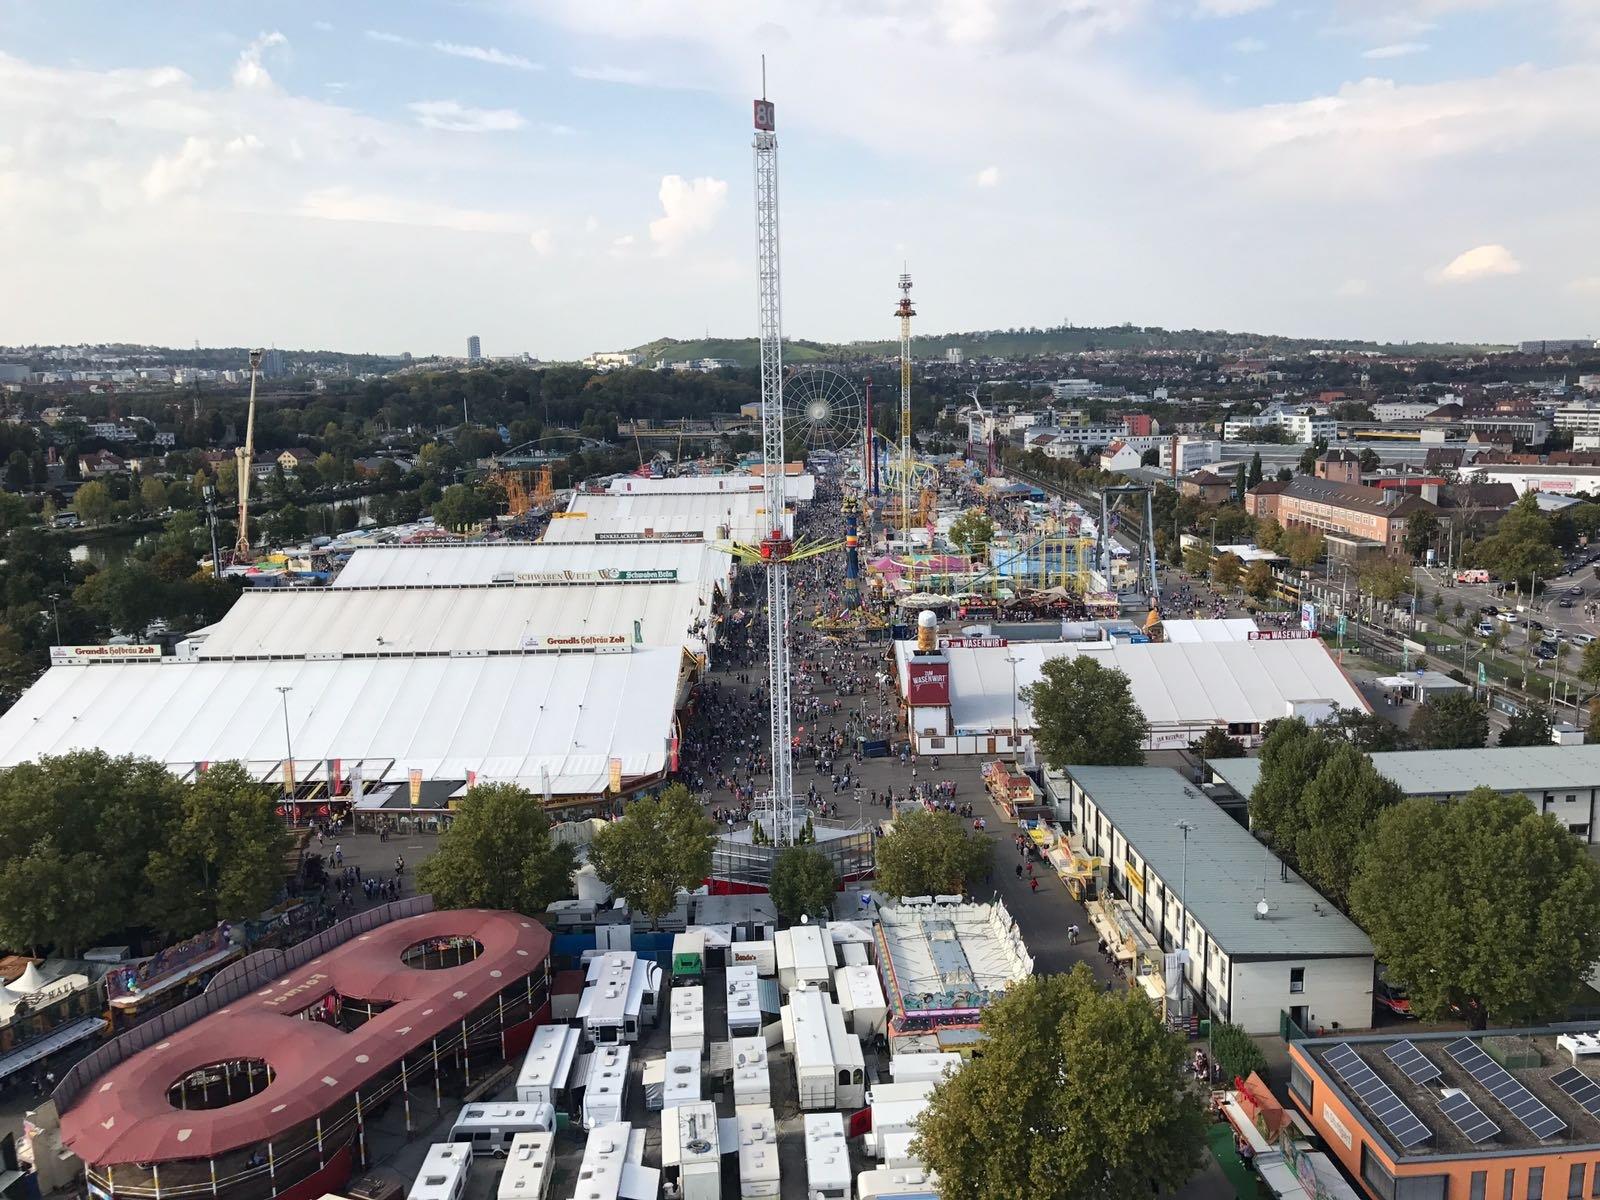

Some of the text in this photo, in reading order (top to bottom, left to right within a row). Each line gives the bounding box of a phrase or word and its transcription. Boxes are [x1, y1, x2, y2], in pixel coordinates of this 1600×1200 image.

[1271, 630, 1313, 639] WASENWIRT
[547, 637, 580, 645] Grandls
[609, 635, 625, 644] Zelt
[962, 638, 1005, 648] WASENWIRT
[138, 646, 154, 654] Zelt
[912, 674, 947, 684] WASENWIRT
